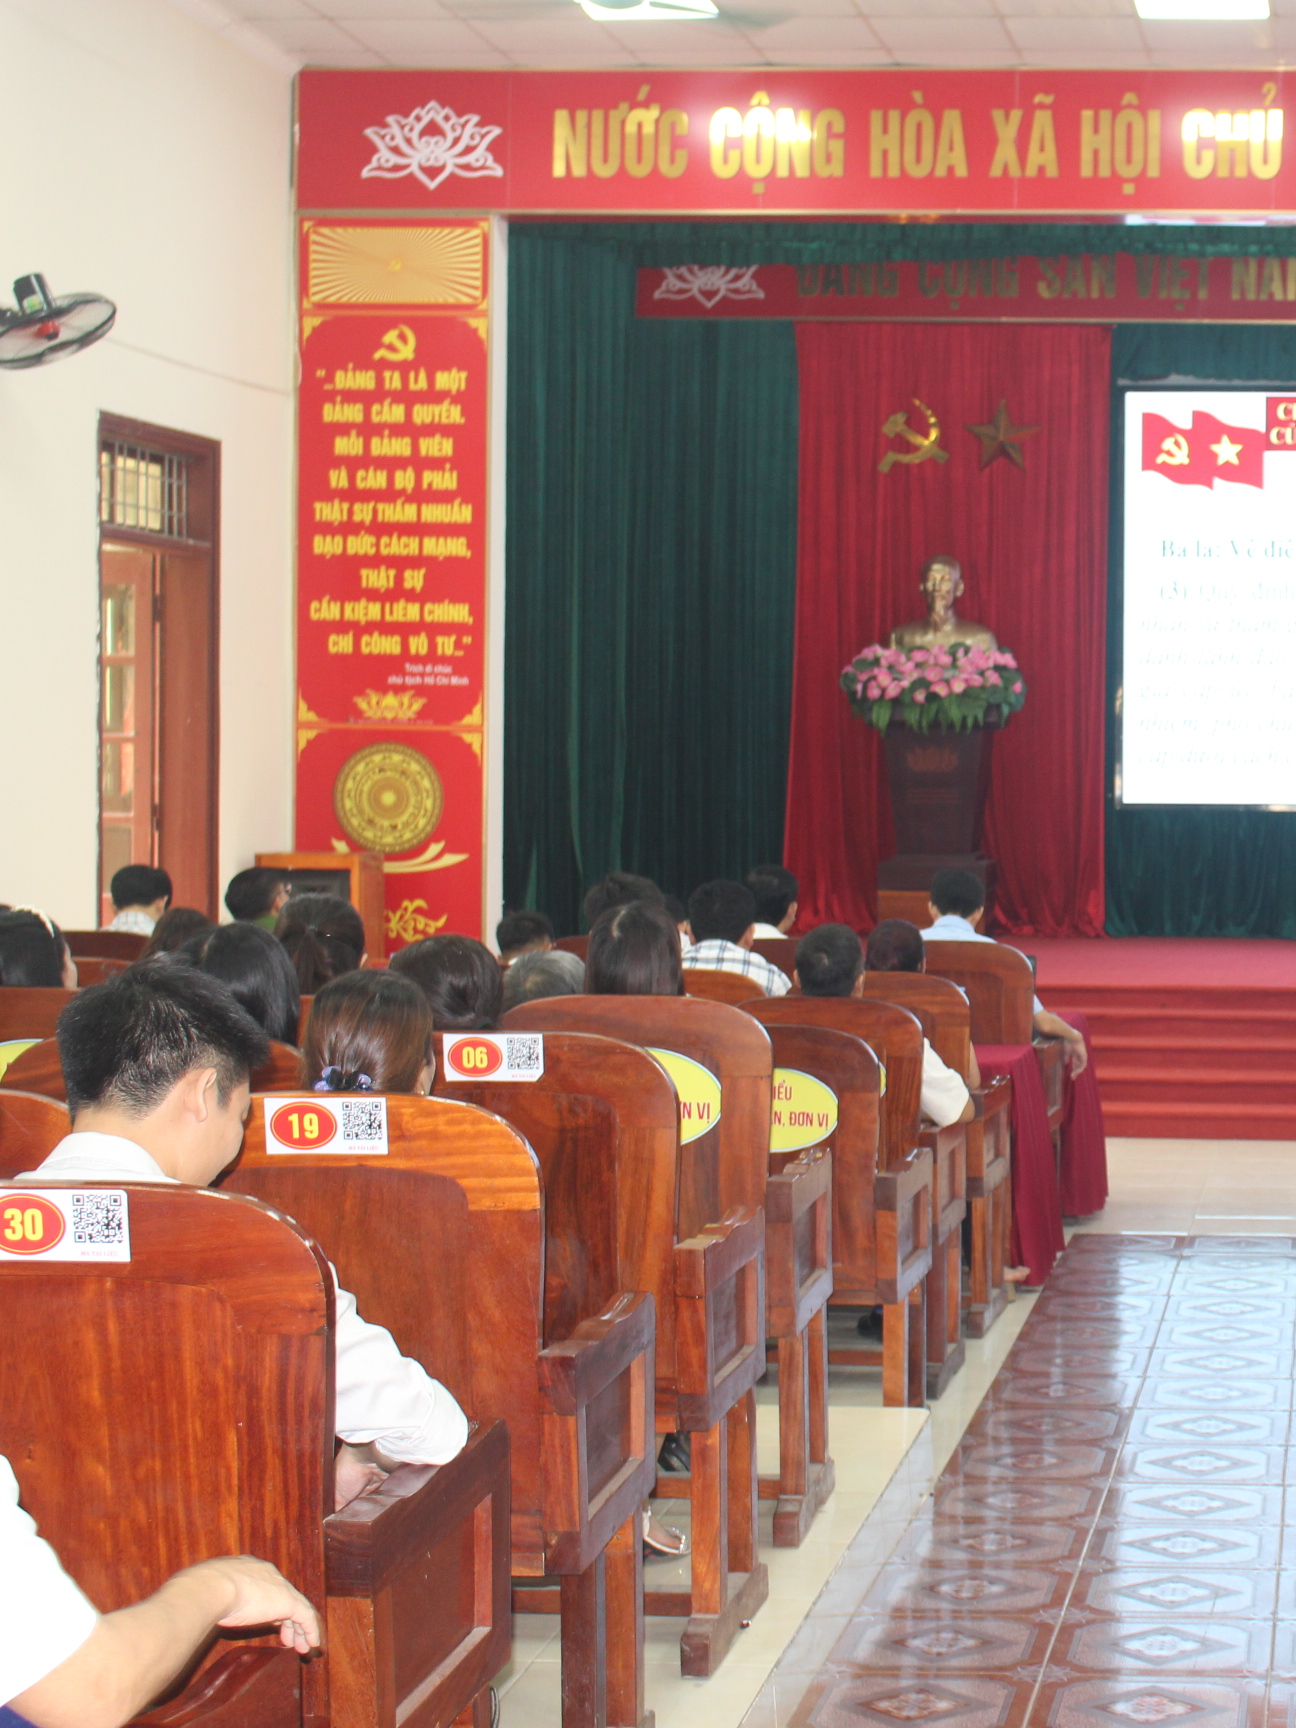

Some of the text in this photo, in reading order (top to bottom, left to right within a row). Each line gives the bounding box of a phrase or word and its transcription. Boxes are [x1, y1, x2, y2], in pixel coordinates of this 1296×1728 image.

[552, 85, 690, 179] NƯỚC
[709, 90, 846, 195] CỘNG
[869, 90, 969, 179] HÒA
[989, 92, 1059, 179] XÃ
[1080, 92, 1161, 195] HỘI
[1181, 81, 1285, 180] CHỦ
[383, 370, 402, 390] TA
[409, 367, 428, 391] LÀ
[435, 367, 468, 395] MỘT
[322, 395, 364, 423] ĐẢNG
[371, 398, 405, 424] CẦM
[334, 429, 453, 457] MỖI ĐẢNG VIÊN
[329, 462, 457, 495] VÀ CÁN BỘ PHẢI
[314, 498, 349, 527] THẬT
[352, 501, 375, 527] SỰ
[313, 534, 343, 560] ĐẠO
[346, 530, 376, 557] ĐỨC
[380, 532, 419, 557] CÁCH
[1162, 540, 1186, 558] Ba
[360, 565, 426, 594] THẬT SỰ
[310, 594, 341, 621] CẦN
[344, 597, 381, 626] KIỆM
[385, 598, 420, 622] LIÊM
[328, 630, 353, 654] CHÍ
[361, 631, 401, 655] CÔNG
[408, 631, 428, 655] VÔ
[462, 1046, 488, 1069] 06
[288, 1113, 319, 1139] 19
[697, 1102, 711, 1124] VỊ
[789, 1112, 814, 1126] ĐƠN
[817, 1114, 829, 1130] VỊ
[3, 1208, 44, 1241] 30
